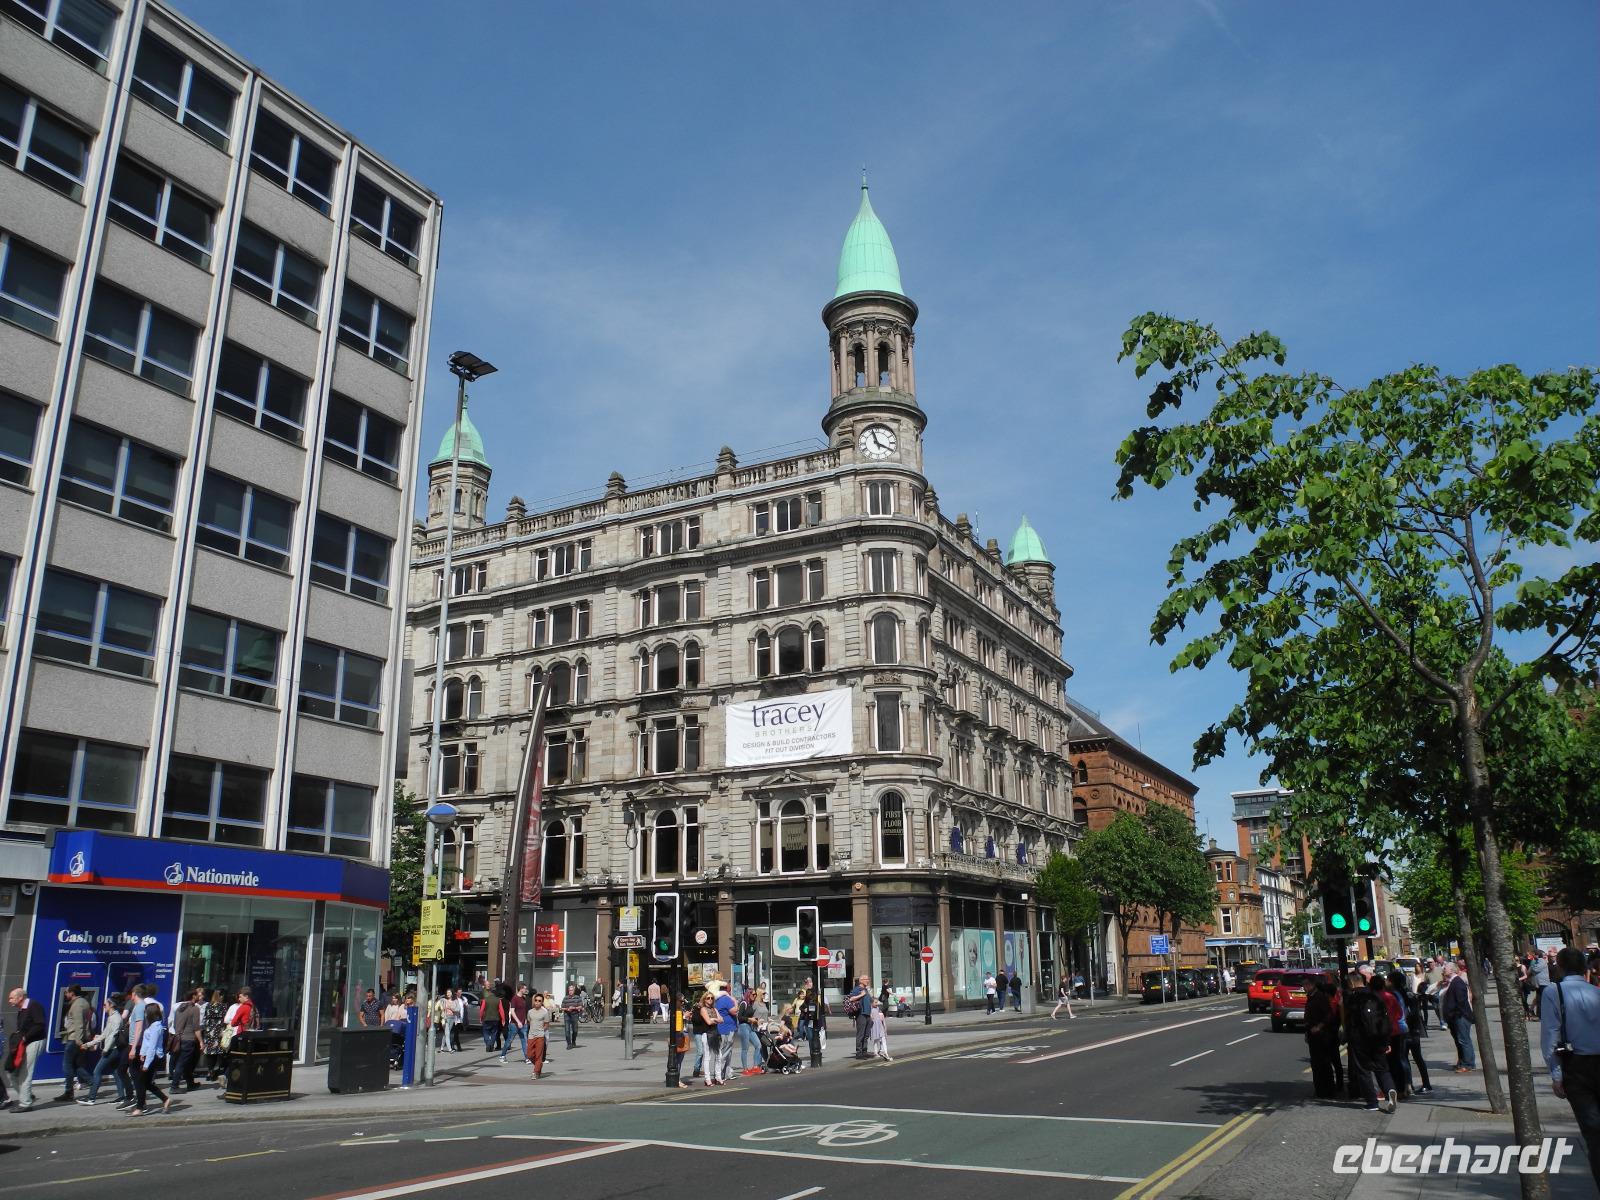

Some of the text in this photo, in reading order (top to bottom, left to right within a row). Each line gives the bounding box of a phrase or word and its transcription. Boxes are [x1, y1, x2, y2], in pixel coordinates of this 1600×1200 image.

[752, 703, 826, 731] tracey
[755, 727, 813, 737] BROTHERS
[772, 738, 790, 746] BUILD
[791, 732, 836, 745] CONTRACTORS
[765, 746, 775, 754] FIT
[788, 743, 815, 752] DIVISION
[185, 866, 259, 887] Nationwide
[58, 930, 157, 948] Cash on the go
